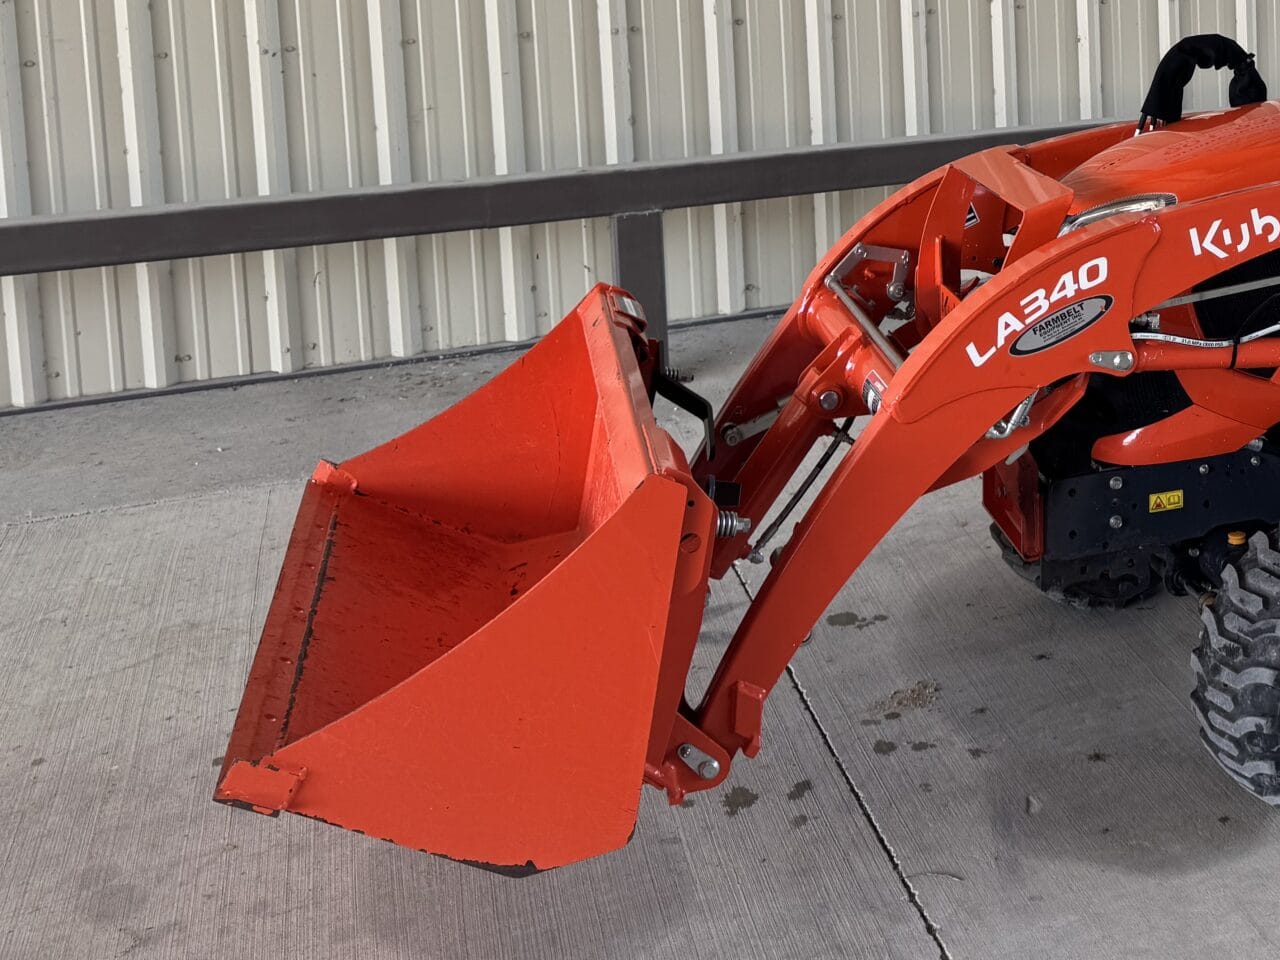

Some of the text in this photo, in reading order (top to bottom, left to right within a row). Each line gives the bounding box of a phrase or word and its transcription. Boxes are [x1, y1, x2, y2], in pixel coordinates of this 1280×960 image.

[965, 256, 1108, 368] LA340
[1032, 302, 1085, 335] FARMBELT
[1039, 317, 1072, 338] EQUIPMENT
